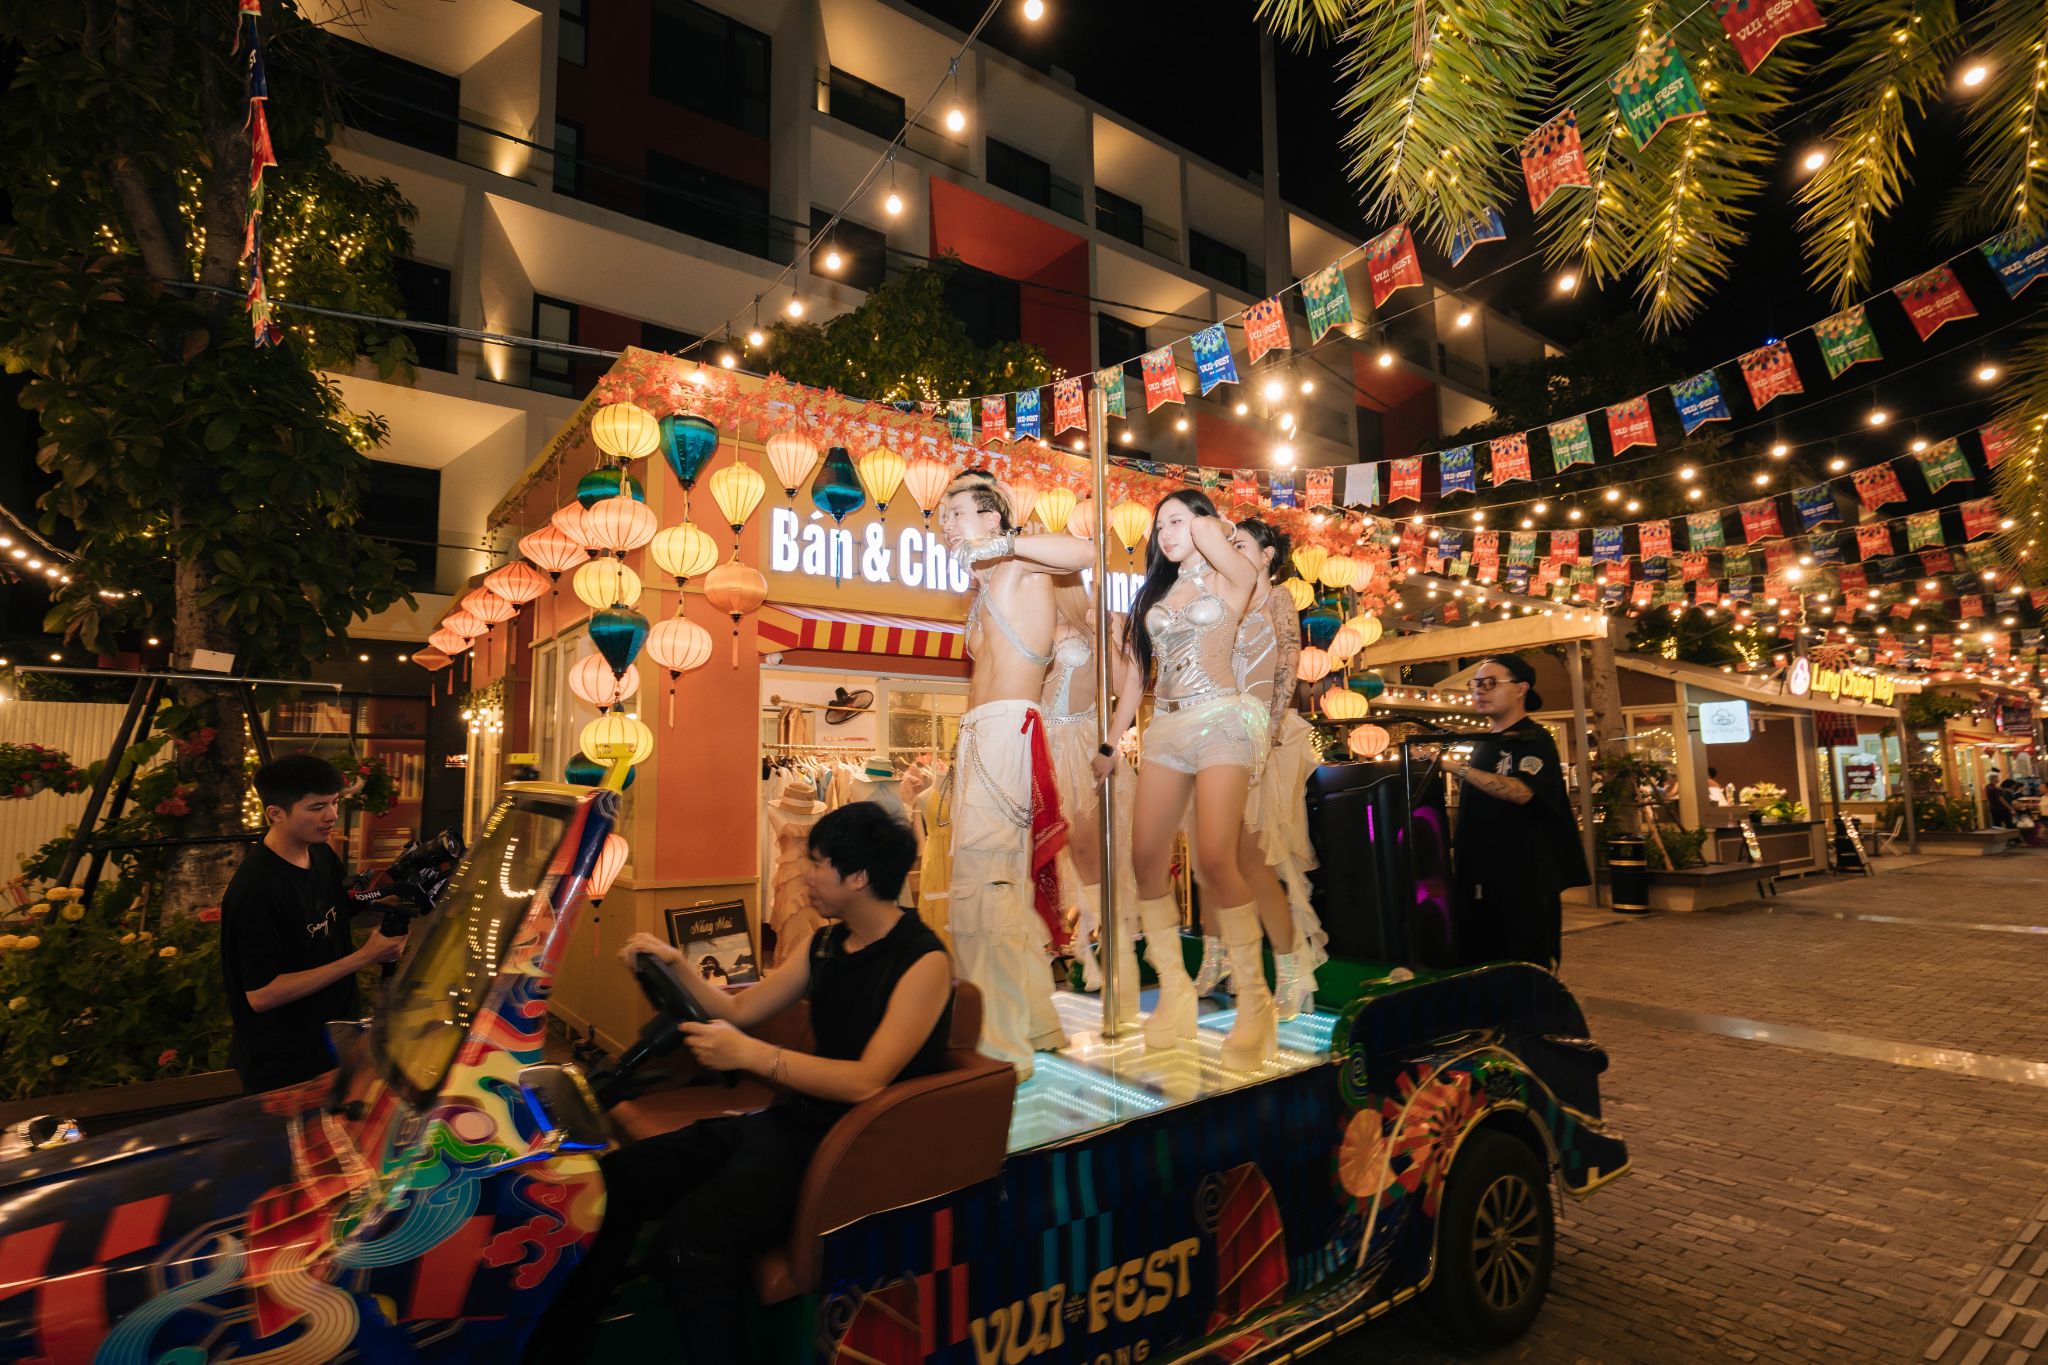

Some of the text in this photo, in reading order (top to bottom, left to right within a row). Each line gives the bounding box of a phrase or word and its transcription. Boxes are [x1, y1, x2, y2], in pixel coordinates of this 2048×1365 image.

[1736, 18, 1763, 41] VUI
[1629, 77, 1685, 120] VUI FEST
[1530, 149, 1579, 183] VUI FEST
[1374, 254, 1412, 283] VUI FEST
[1311, 295, 1344, 320] VUI FEST
[1200, 355, 1230, 373] VUI FEST
[1147, 377, 1176, 391] VUI FEST
[772, 507, 853, 580] Bán
[862, 522, 891, 582] &
[969, 1236, 1201, 1365] VUI FEST
[1079, 1338, 1151, 1365] ONG
